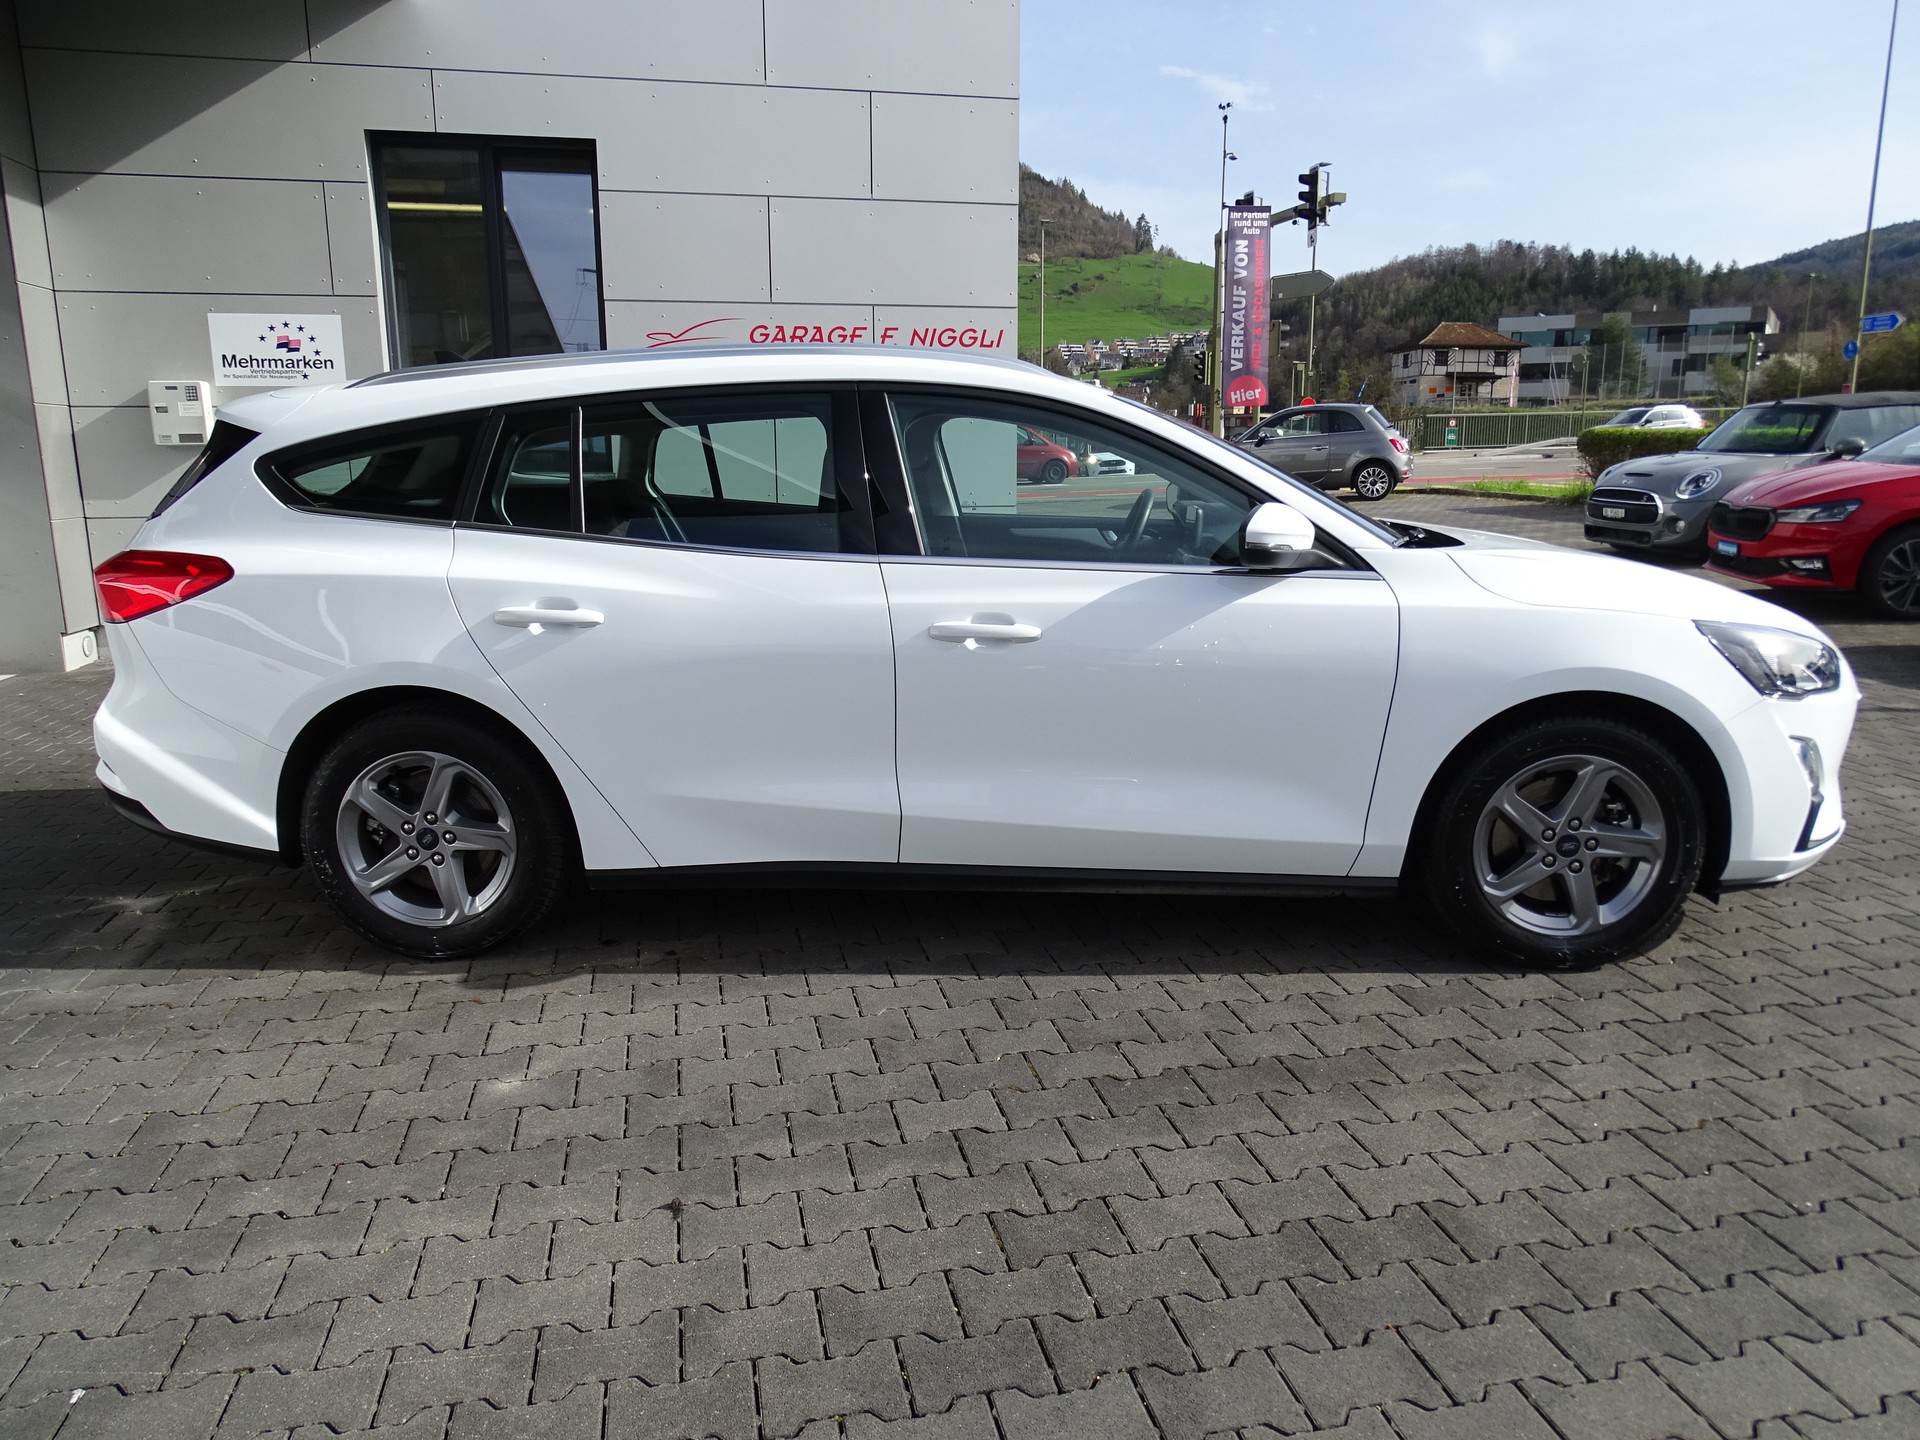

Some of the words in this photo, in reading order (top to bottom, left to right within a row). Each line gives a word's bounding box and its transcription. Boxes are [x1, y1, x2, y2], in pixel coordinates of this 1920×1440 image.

[1234, 240, 1249, 279] VON
[909, 327, 1004, 348] NIGGLI
[1231, 285, 1247, 371] VERKAUF
[221, 354, 335, 369] Mehrmarken
[1230, 388, 1262, 404] Hier
